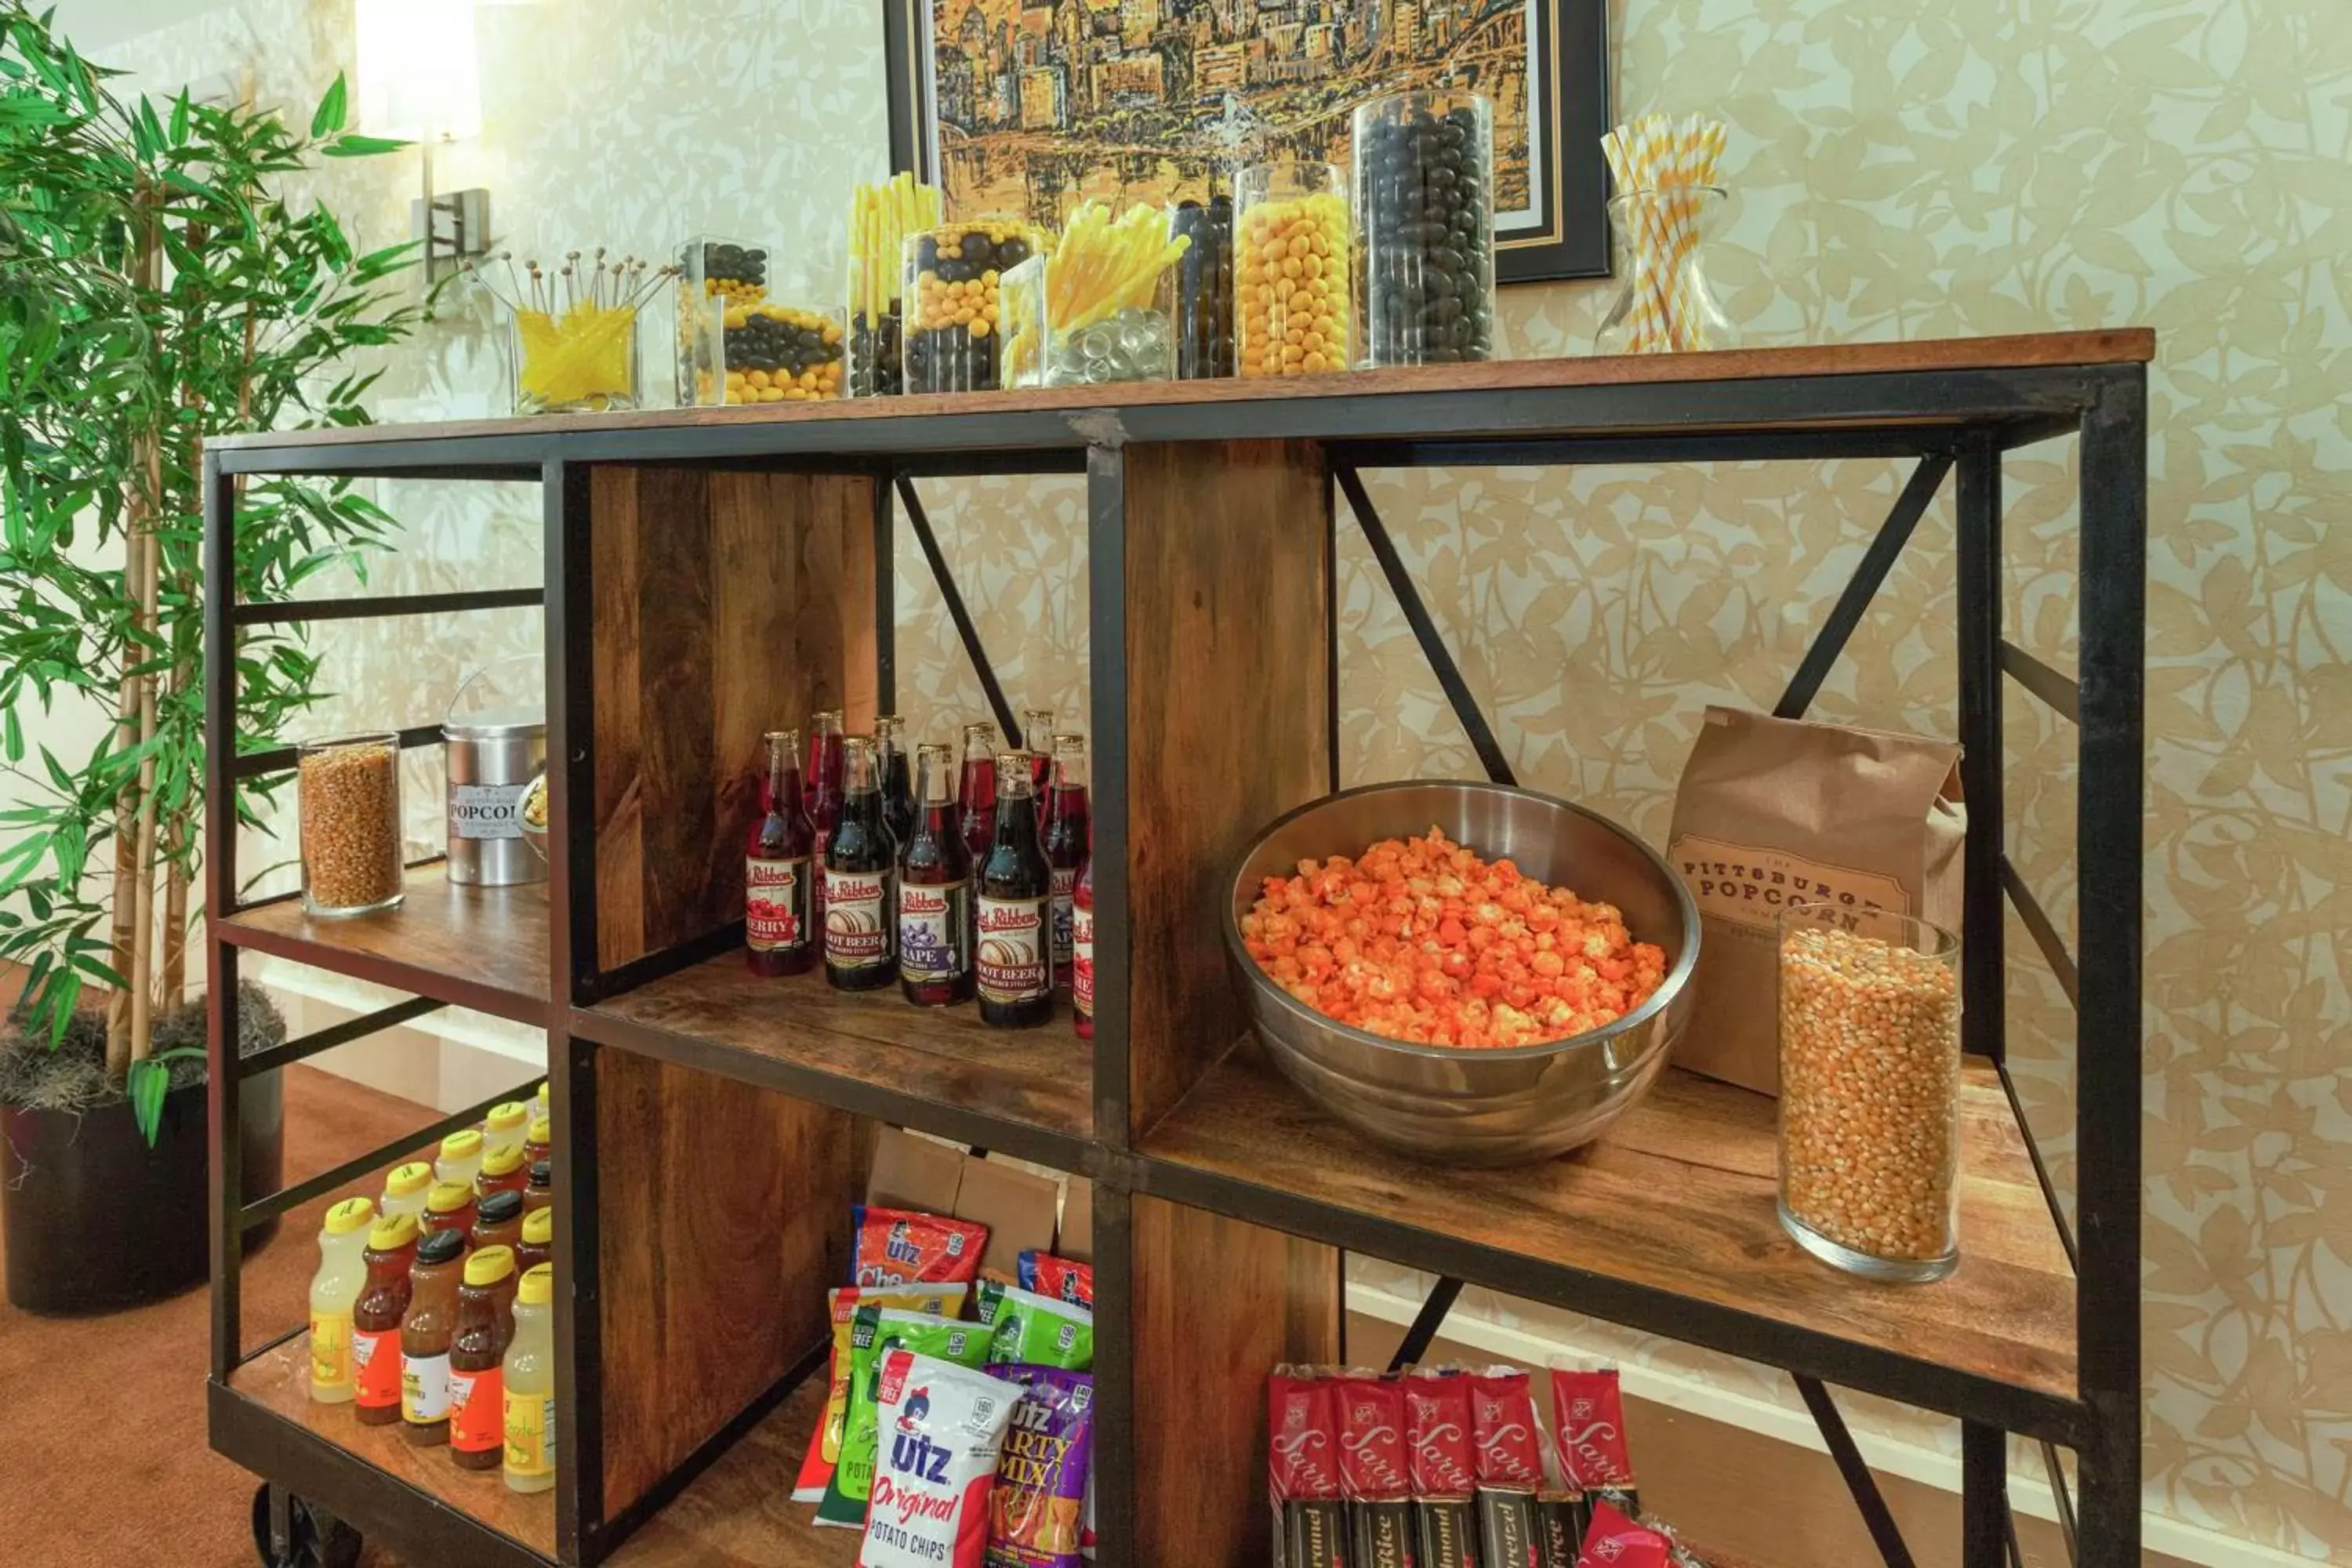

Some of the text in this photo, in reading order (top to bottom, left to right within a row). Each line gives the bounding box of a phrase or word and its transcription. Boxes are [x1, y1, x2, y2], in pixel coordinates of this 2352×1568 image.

[837, 879, 880, 898] Ribbon
[904, 891, 944, 909] Ribbon
[1700, 880, 1860, 931] POPCORN
[993, 907, 1036, 925] Ribbon
[749, 918, 788, 933] ERRY
[846, 935, 879, 947] BEER
[1002, 967, 1036, 979] BEER
[874, 1476, 960, 1525] Original
[870, 1518, 946, 1562] POTATO CHIPS
